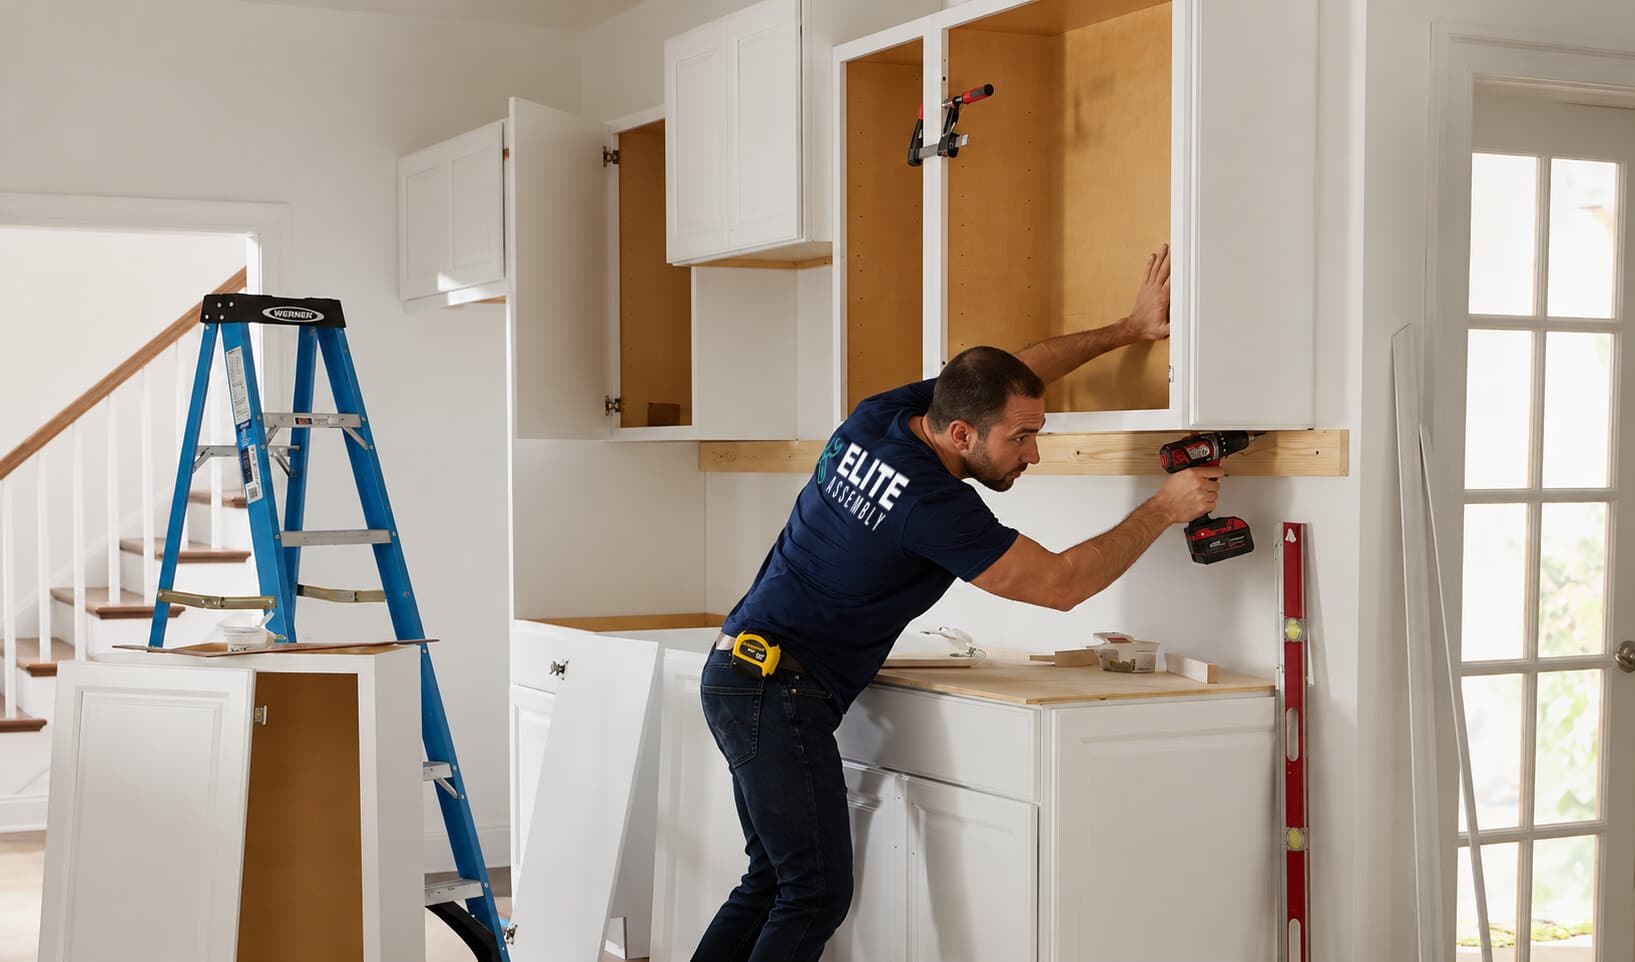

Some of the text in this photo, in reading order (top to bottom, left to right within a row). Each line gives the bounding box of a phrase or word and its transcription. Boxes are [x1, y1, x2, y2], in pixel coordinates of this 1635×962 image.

[274, 309, 313, 319] WERNER
[825, 475, 886, 531] ASSEMBLY
[836, 442, 910, 511] ELITE
